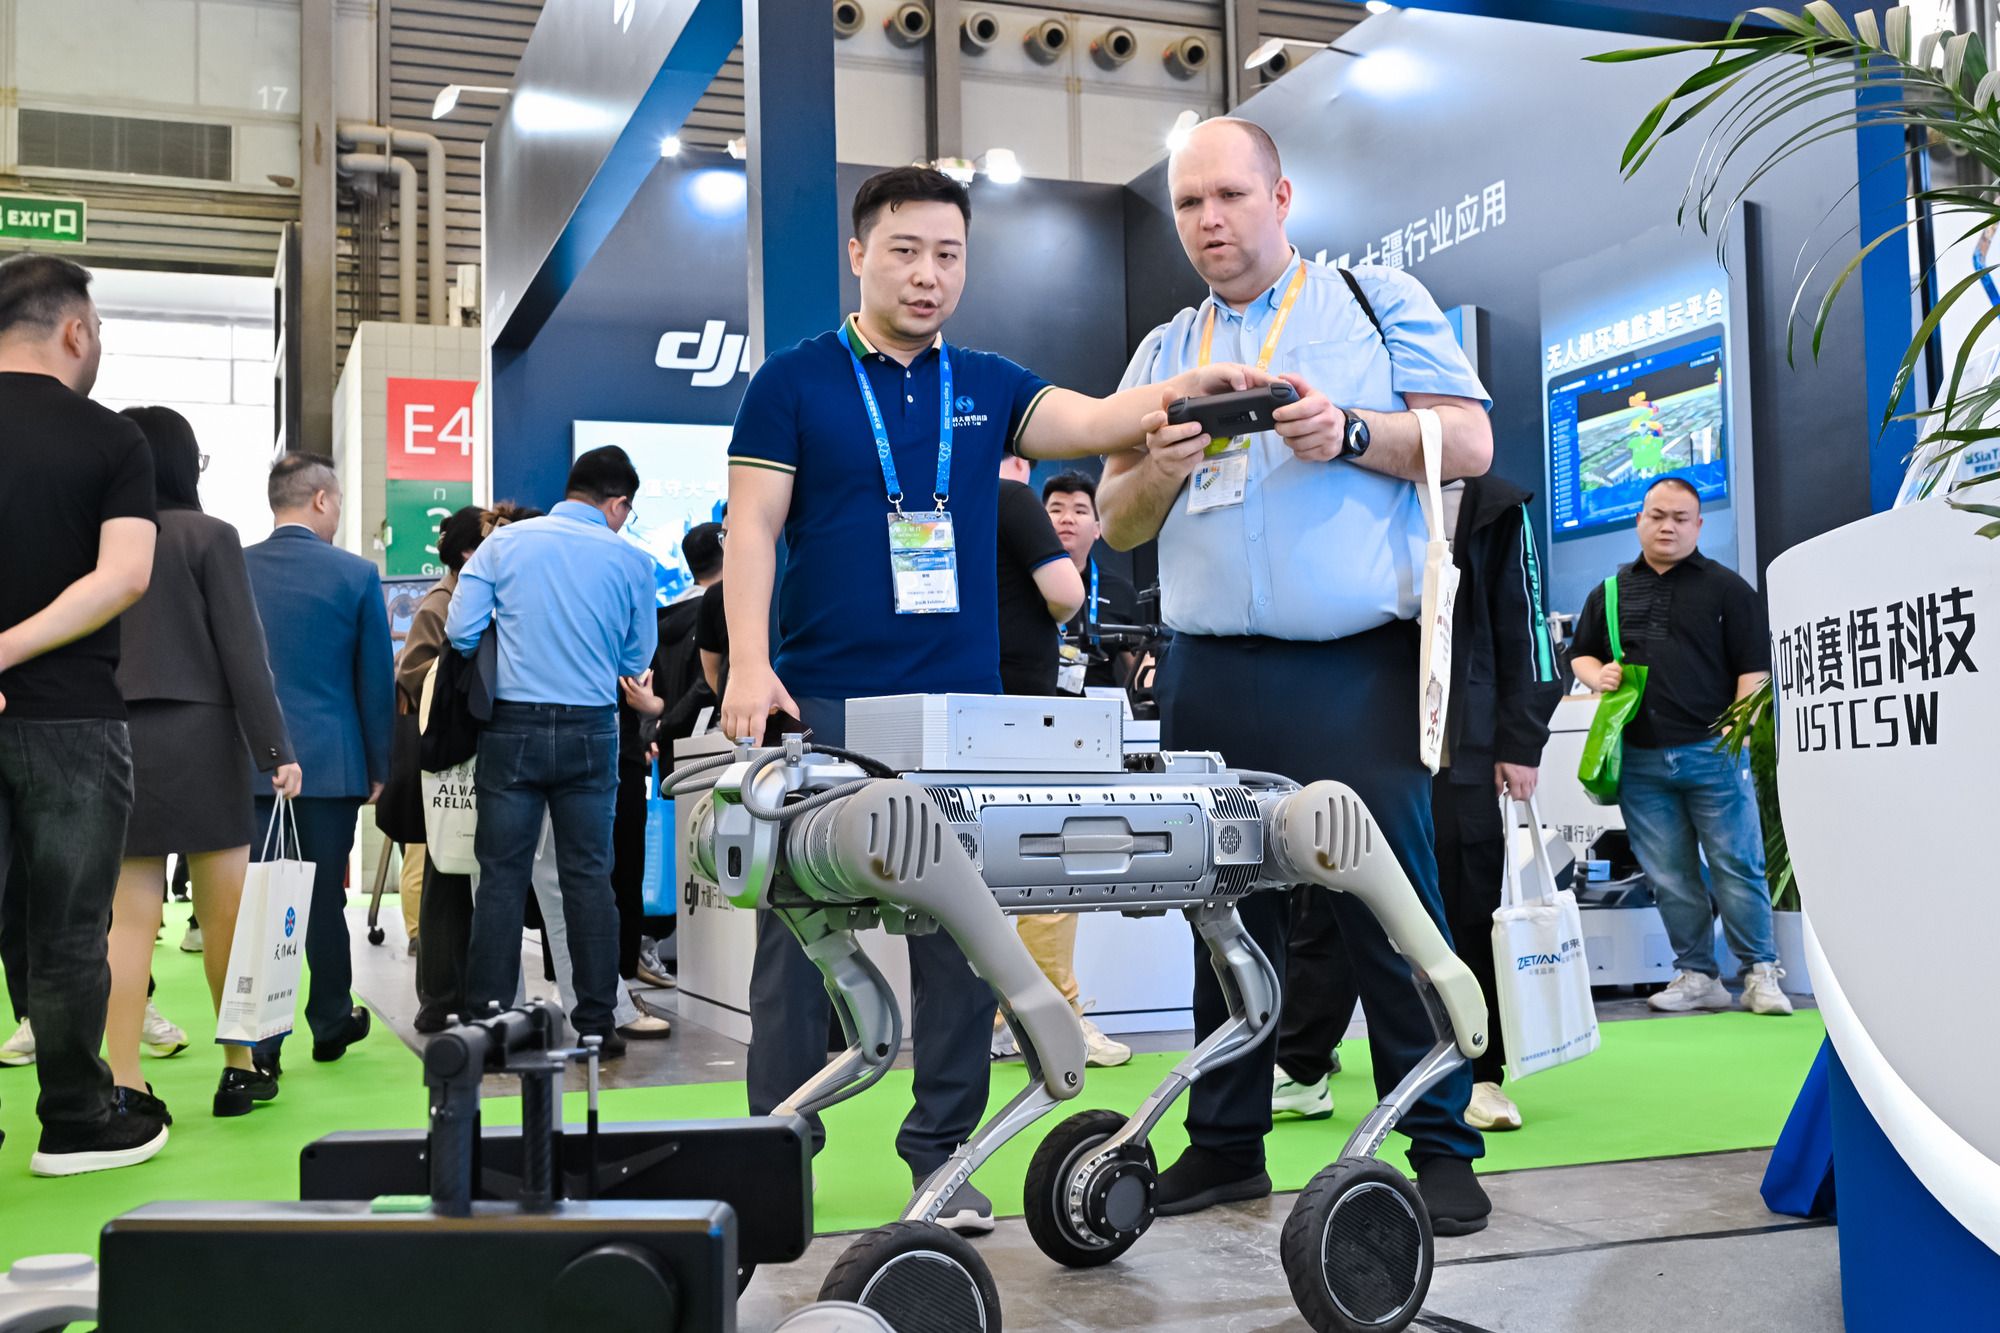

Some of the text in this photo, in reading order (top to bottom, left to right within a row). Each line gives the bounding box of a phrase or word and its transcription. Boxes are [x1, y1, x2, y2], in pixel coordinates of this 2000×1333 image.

[257, 86, 288, 111] 17
[7, 209, 52, 228] EXIT
[1547, 288, 1723, 372] 无人机环境监测云平台
[404, 403, 473, 456] E4
[421, 563, 450, 576] Gat
[1779, 586, 1979, 700] 中科赛悟科技
[1796, 691, 1938, 752] USTCSW
[684, 874, 699, 915] dji
